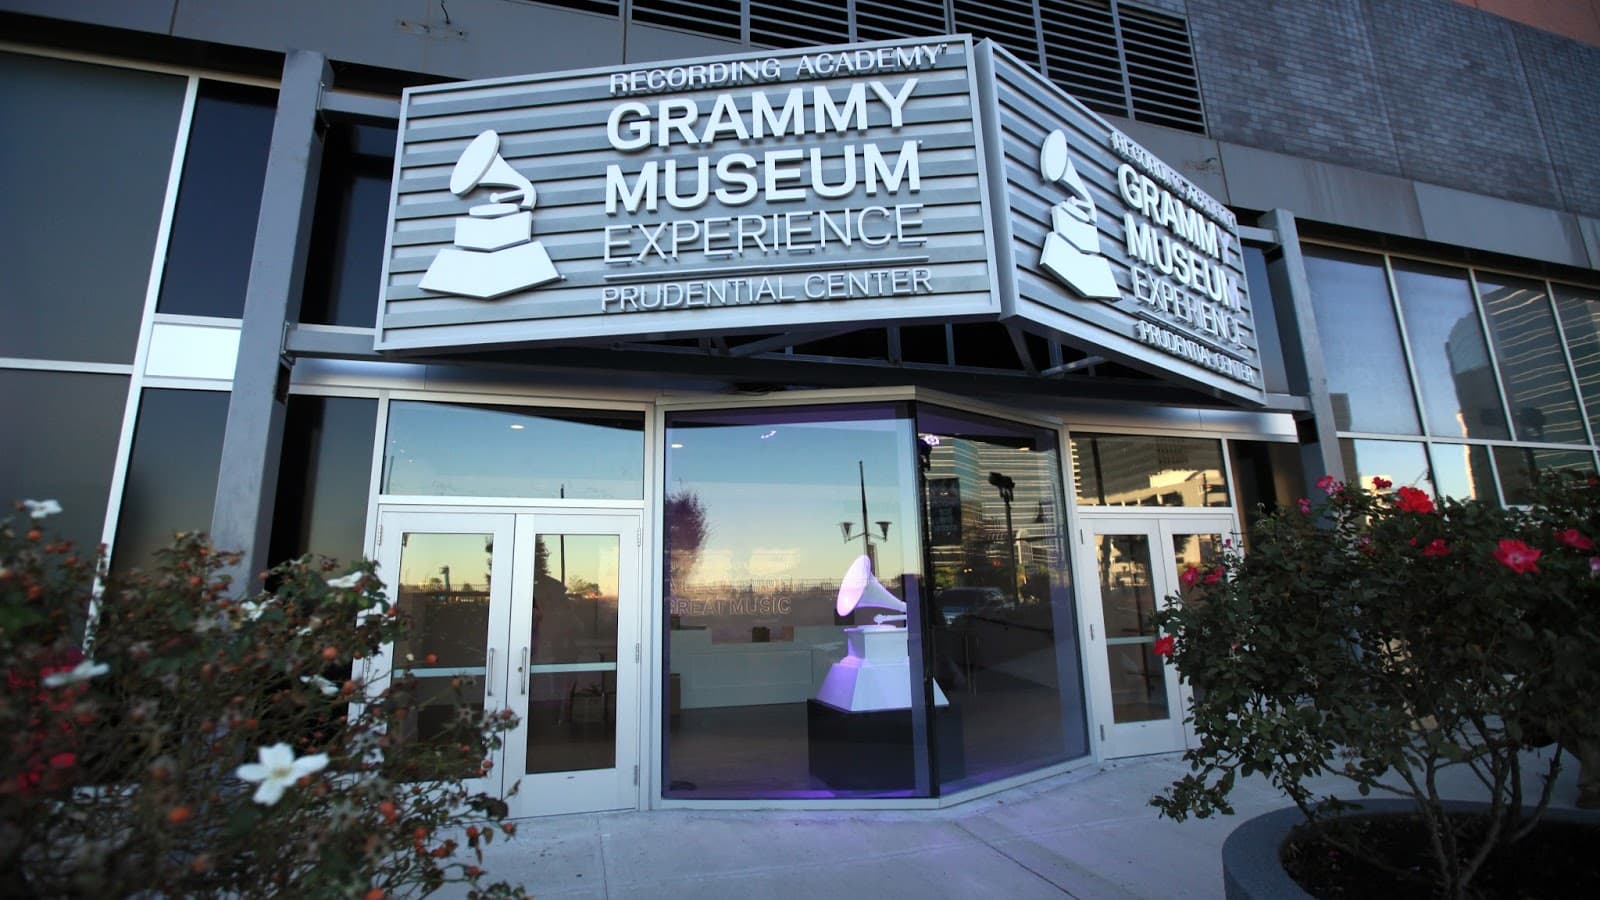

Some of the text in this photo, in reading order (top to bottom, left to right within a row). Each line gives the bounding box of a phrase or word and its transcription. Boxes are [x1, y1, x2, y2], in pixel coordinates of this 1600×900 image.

[609, 44, 941, 95] RECORDING ACADEMY
[606, 78, 919, 151] GRAMMY
[604, 140, 921, 215] MUSEUM
[603, 203, 928, 265] EXPERIENCE
[1117, 163, 1231, 265] GRAMMY
[602, 267, 934, 313] PRUDENTIAL CENTER
[1124, 213, 1241, 313] MUSEUM
[1130, 265, 1248, 350] EXPERIENCE
[1136, 319, 1215, 368] PRUDENTIAL
[729, 596, 793, 617] MUSIC
